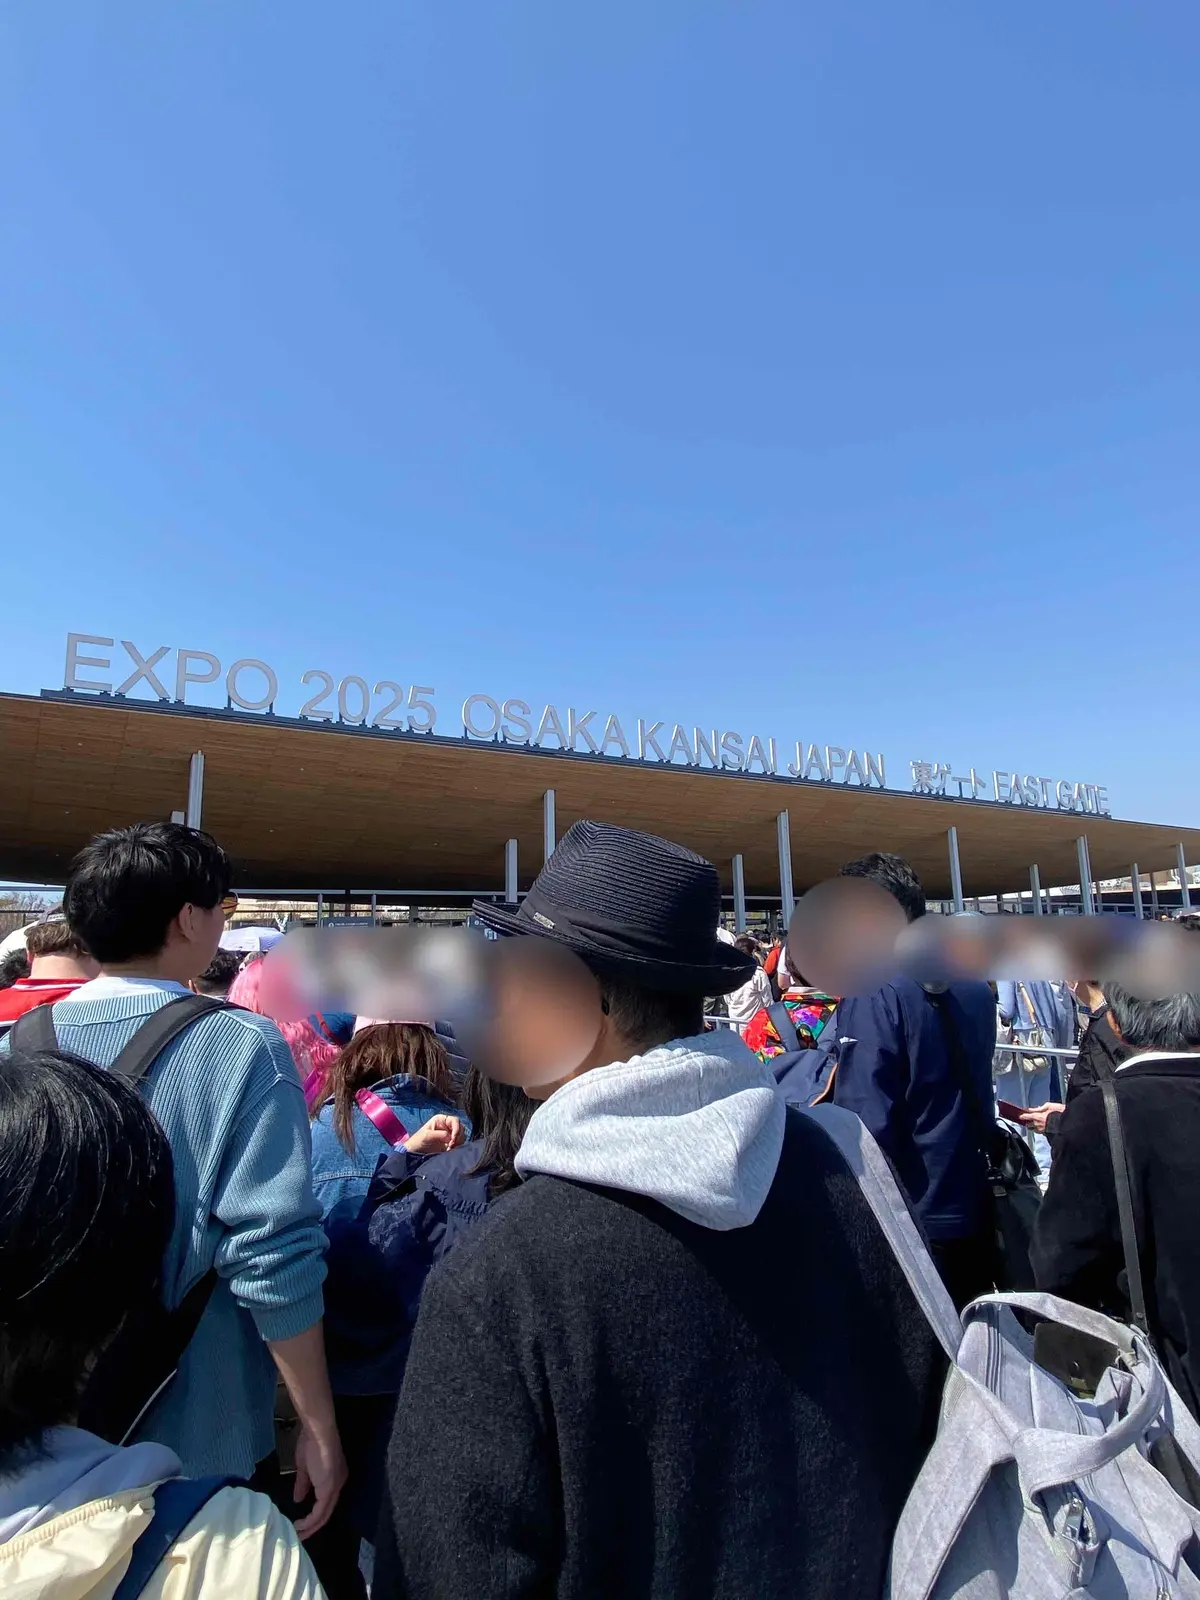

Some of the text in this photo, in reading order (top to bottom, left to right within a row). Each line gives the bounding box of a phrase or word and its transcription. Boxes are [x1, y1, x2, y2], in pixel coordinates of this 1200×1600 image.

[64, 632, 1109, 815] EXPO 2025 OSAKA KANSAI JAPAN 東ゲート EAST GATE
